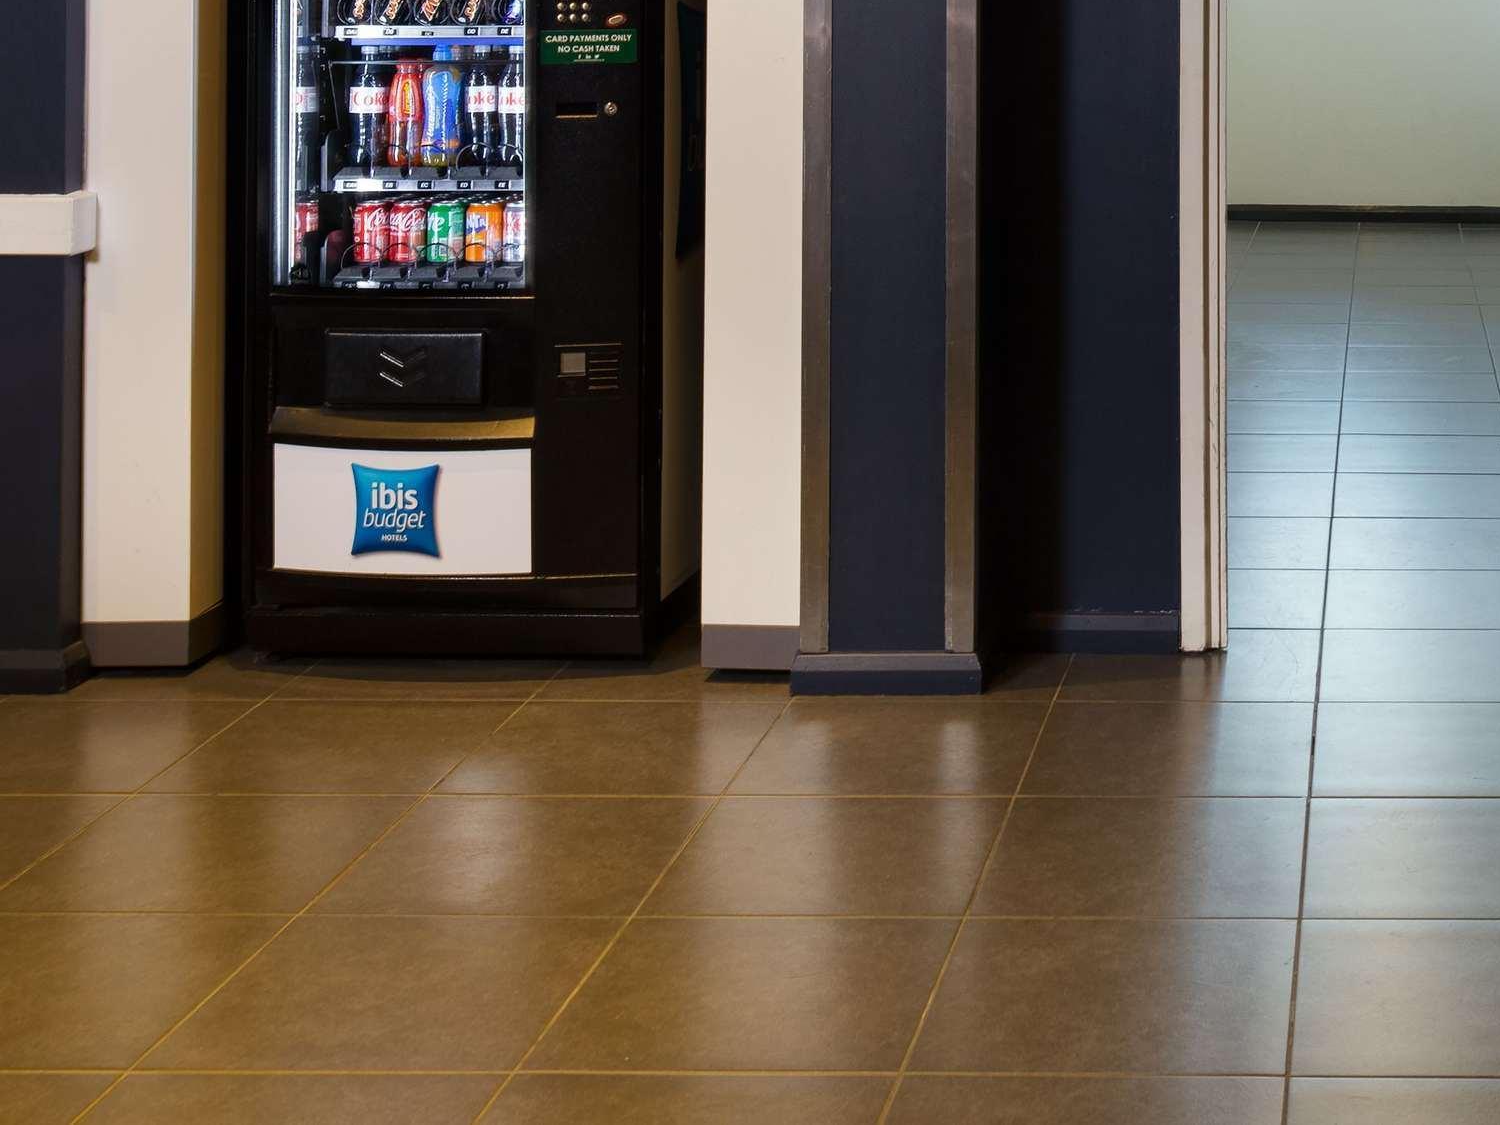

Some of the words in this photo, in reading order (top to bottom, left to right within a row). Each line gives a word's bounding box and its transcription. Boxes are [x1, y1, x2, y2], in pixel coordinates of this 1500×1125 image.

[545, 35, 568, 43] CARD
[569, 34, 610, 43] PAYMENTS
[611, 34, 632, 42] ONLY
[572, 45, 595, 53] CASH
[595, 44, 620, 52] TAKEN
[371, 482, 418, 510] ibis
[363, 508, 427, 532] budget
[381, 534, 407, 542] HOTELS
